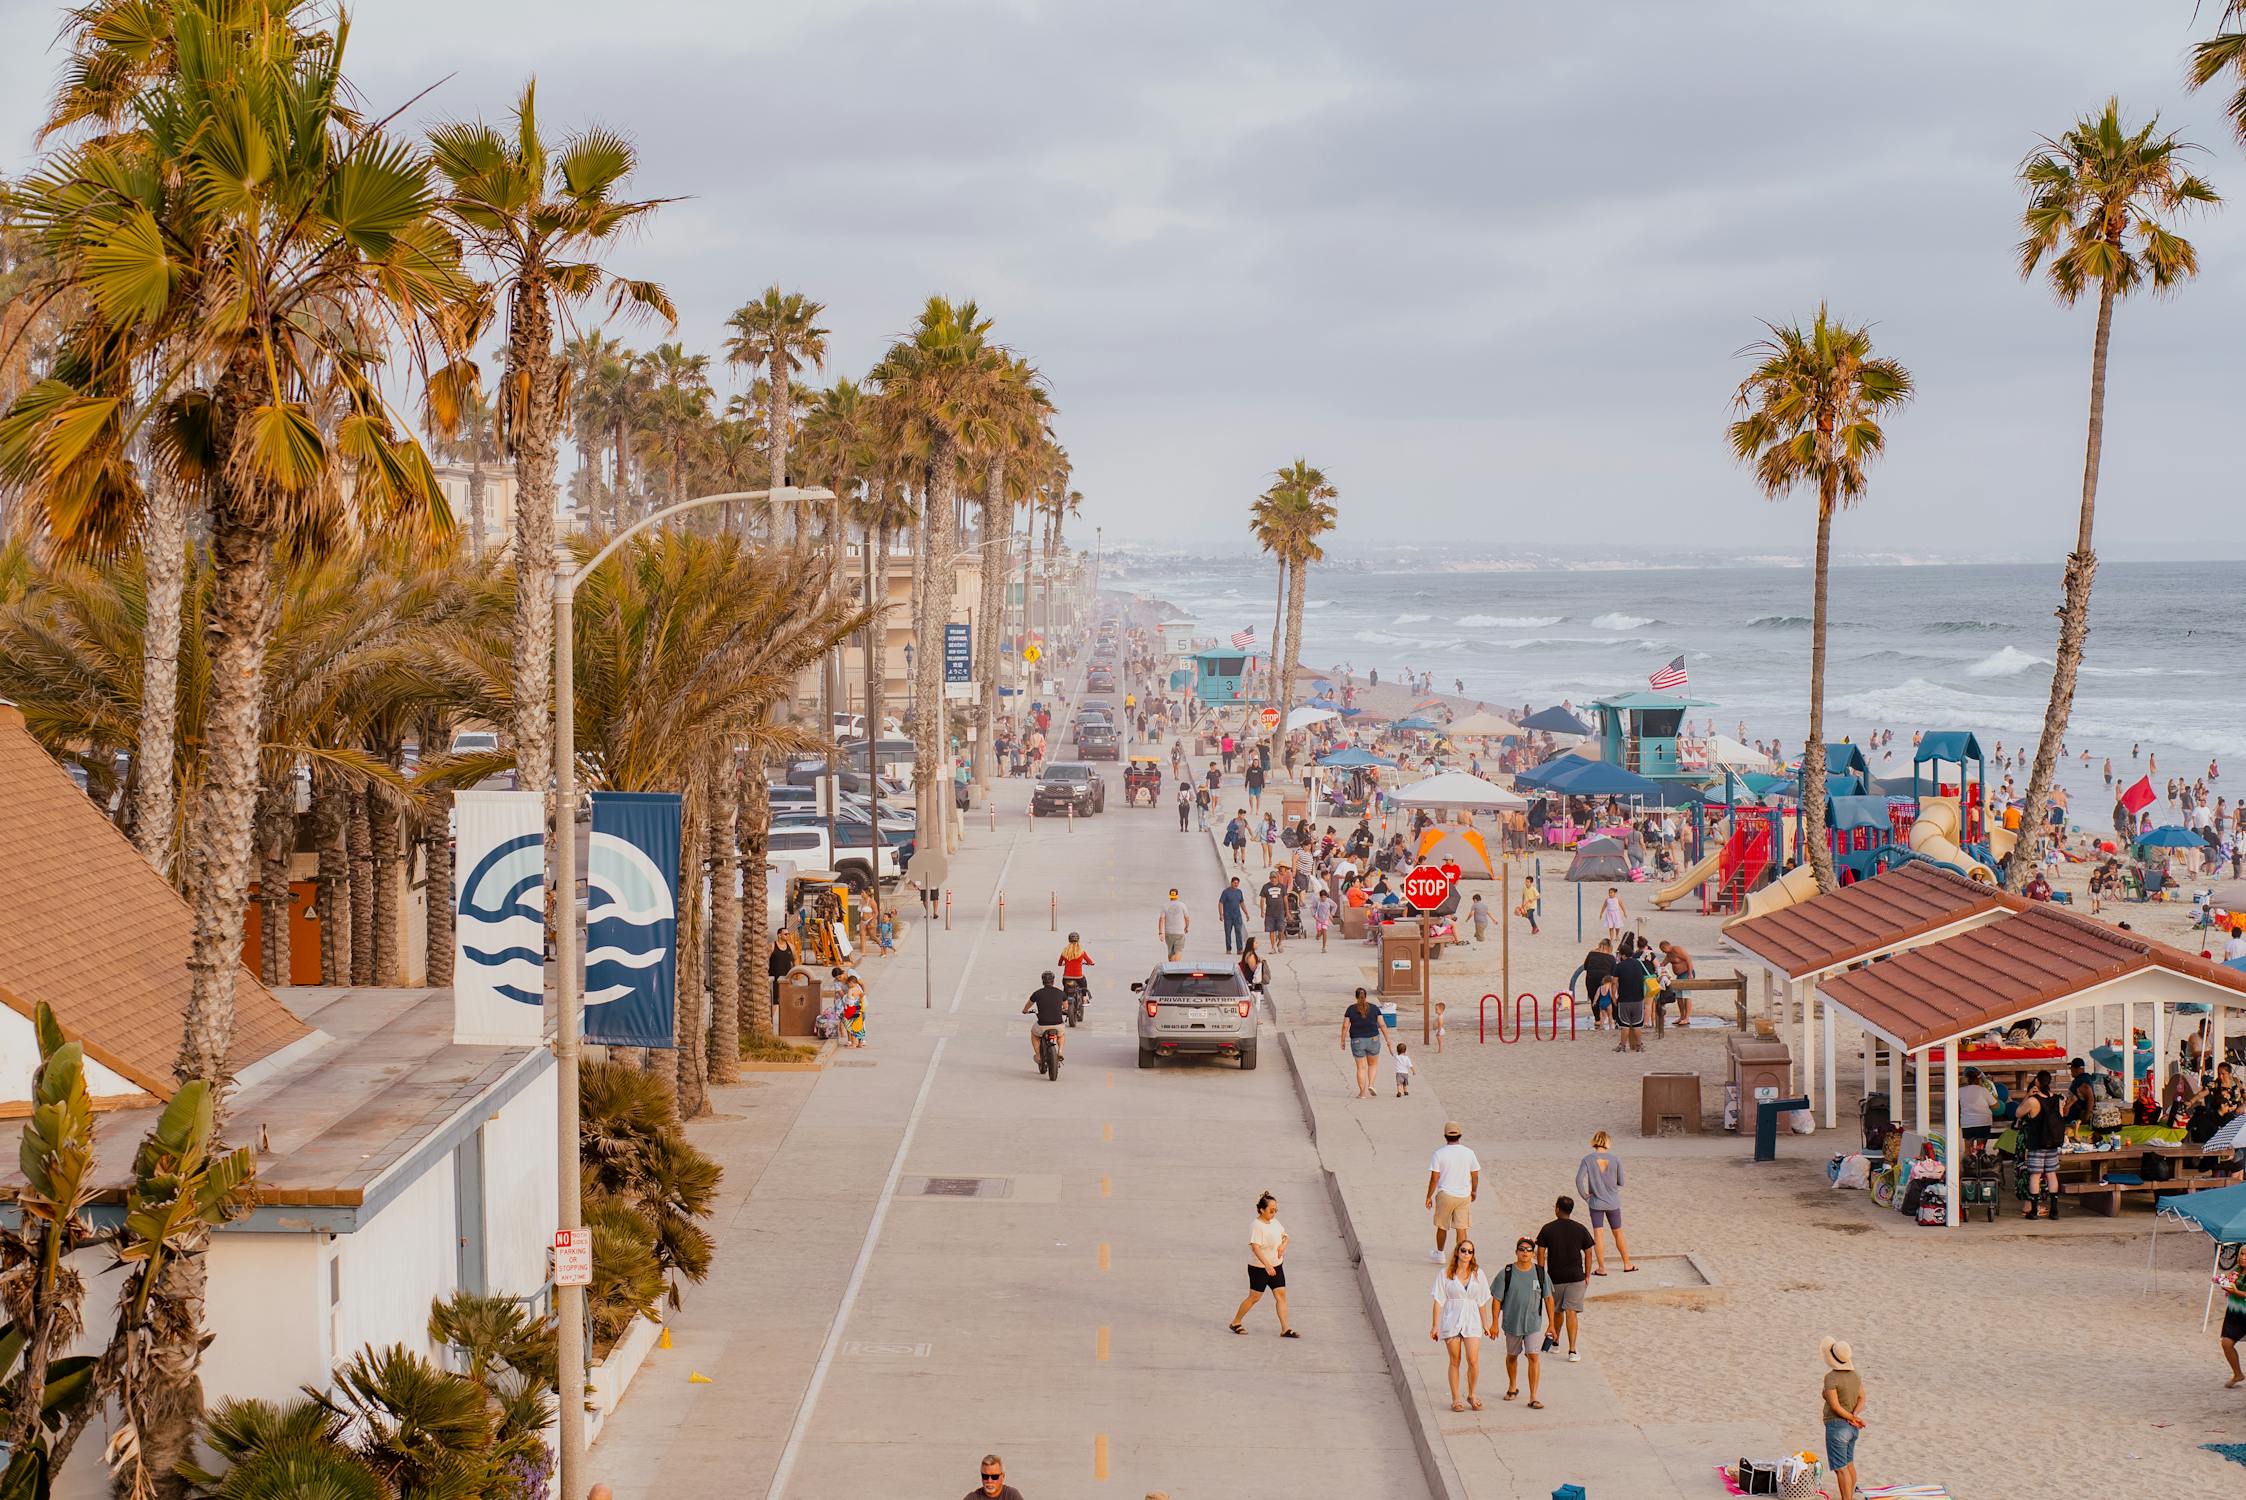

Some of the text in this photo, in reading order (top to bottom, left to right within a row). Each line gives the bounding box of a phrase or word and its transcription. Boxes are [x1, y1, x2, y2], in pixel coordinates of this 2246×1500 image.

[1177, 639, 1187, 650] 5
[1225, 680, 1233, 691] 3
[1261, 713, 1279, 722] STOP
[1655, 744, 1662, 760] 1
[1407, 879, 1446, 896] STOP
[556, 1232, 570, 1246] NO
